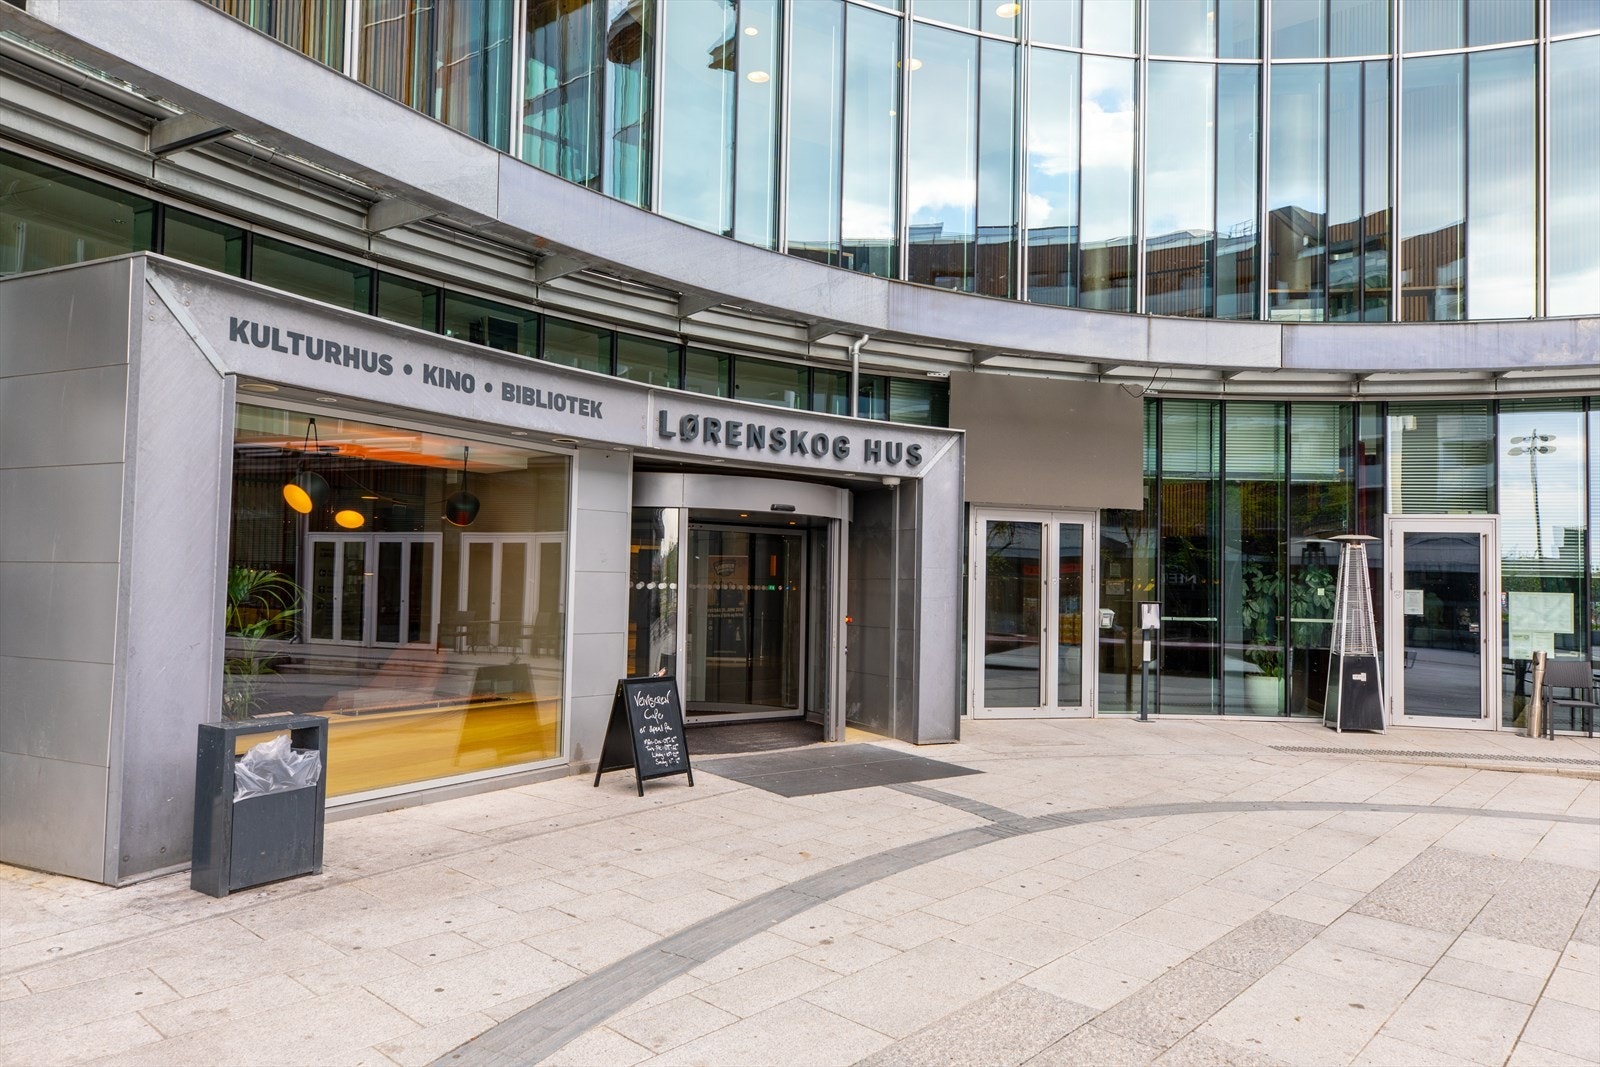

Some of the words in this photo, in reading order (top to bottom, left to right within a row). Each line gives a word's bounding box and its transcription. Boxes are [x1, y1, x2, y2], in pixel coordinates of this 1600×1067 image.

[229, 316, 393, 376] KULTURHUS
[423, 363, 476, 394] KINO
[501, 381, 603, 420] BIBLIOTEK
[658, 409, 850, 460] LØRENSKOG
[864, 438, 923, 467] HUS
